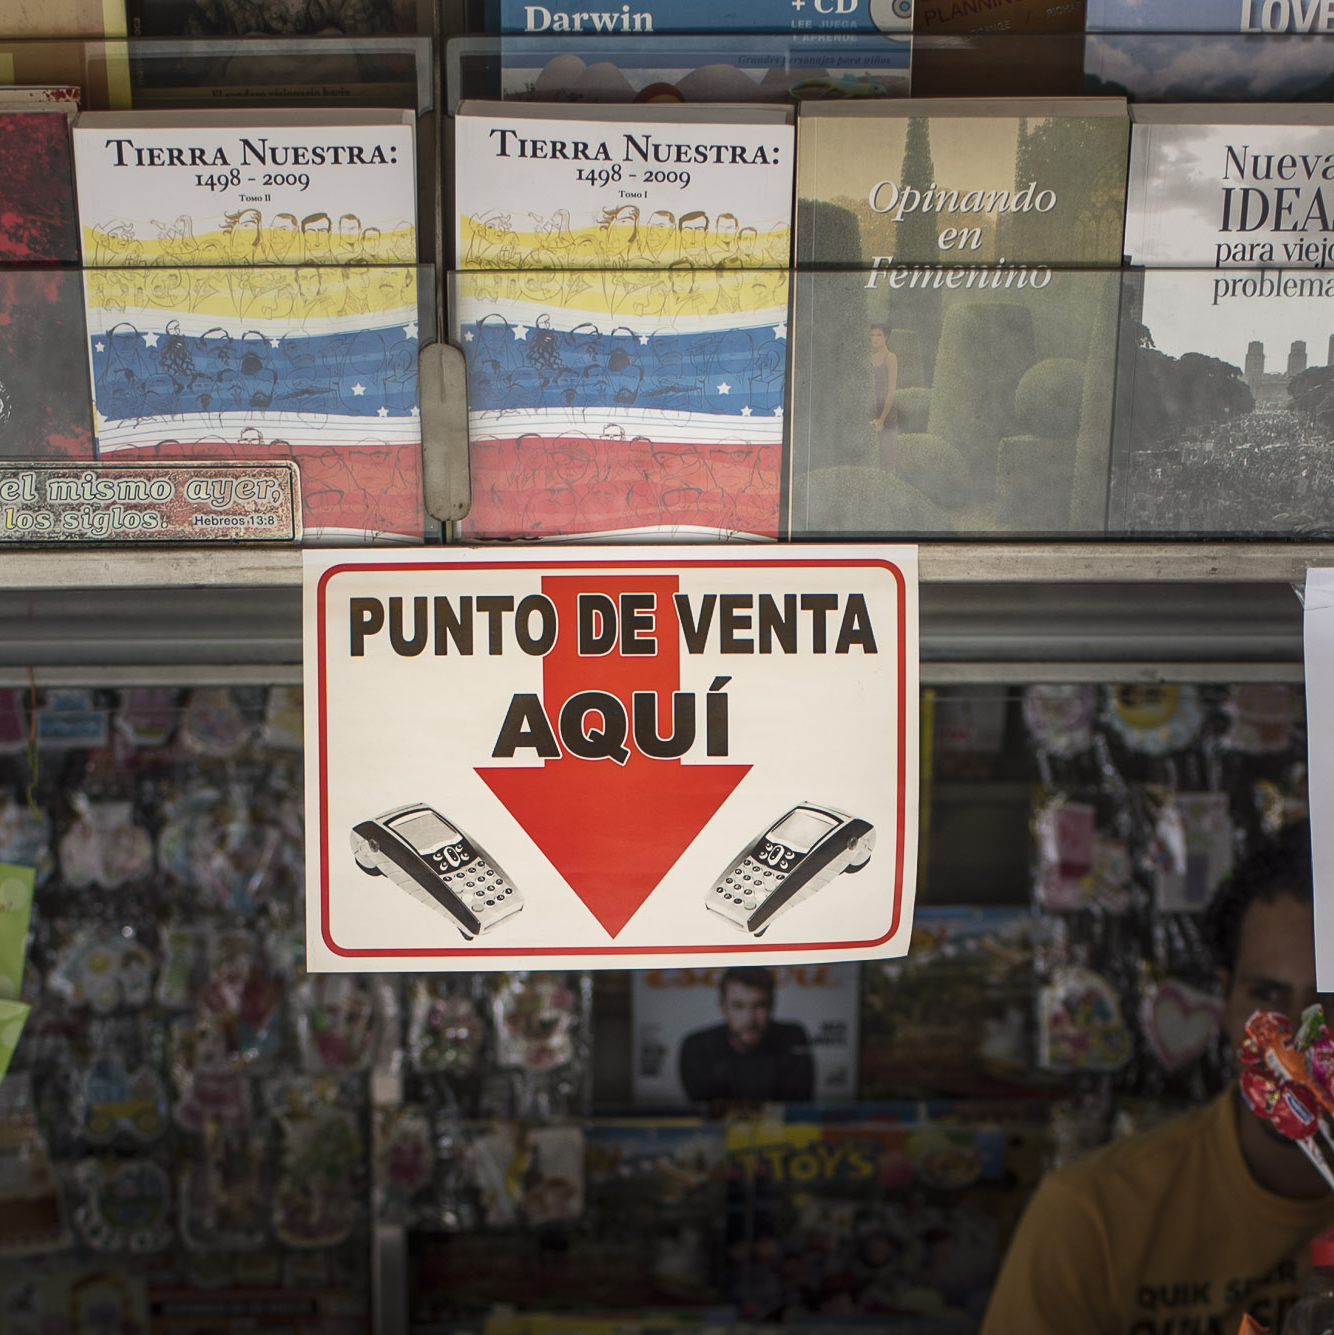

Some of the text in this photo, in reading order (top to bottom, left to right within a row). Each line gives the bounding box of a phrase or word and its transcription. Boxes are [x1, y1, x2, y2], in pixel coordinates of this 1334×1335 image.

[523, 5, 655, 34] Darwin
[194, 172, 311, 192] 1498 2009
[868, 181, 1057, 220] Opinando
[939, 226, 983, 251] en
[1215, 238, 1275, 268] para
[865, 258, 1053, 291] Femenino
[1, 475, 35, 502] el
[48, 478, 172, 503] mismo
[186, 479, 281, 507] ayer,
[6, 508, 52, 531] los
[63, 508, 168, 536] siglos.
[194, 515, 275, 526] Hebreos 13:8
[349, 593, 878, 657] PUNTO DE VENTA
[491, 675, 733, 767] AQUÍ
